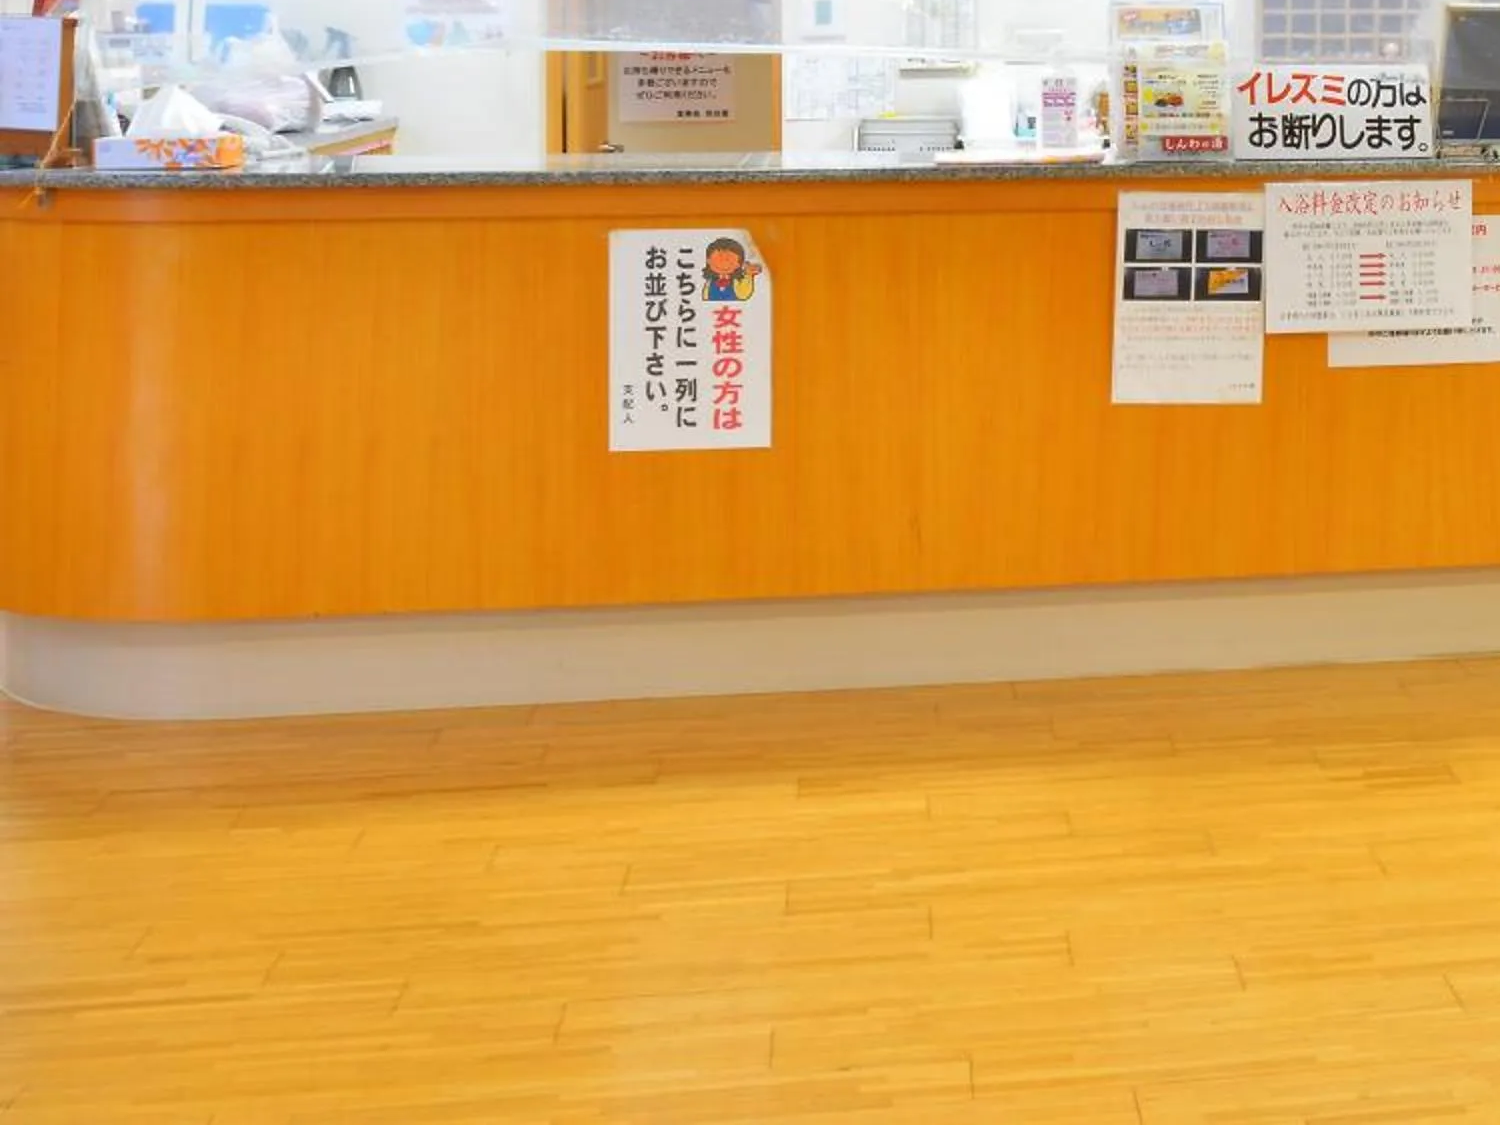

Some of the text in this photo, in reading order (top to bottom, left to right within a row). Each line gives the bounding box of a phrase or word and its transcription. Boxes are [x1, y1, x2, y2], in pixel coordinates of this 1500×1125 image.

[1248, 112, 1429, 152] お断りします。
[1279, 188, 1463, 215] 入浴料金改定のお知らせ
[645, 246, 668, 412] お並び下さい。
[675, 248, 698, 428] こちらに一列に
[712, 306, 744, 430] 女性の方は
